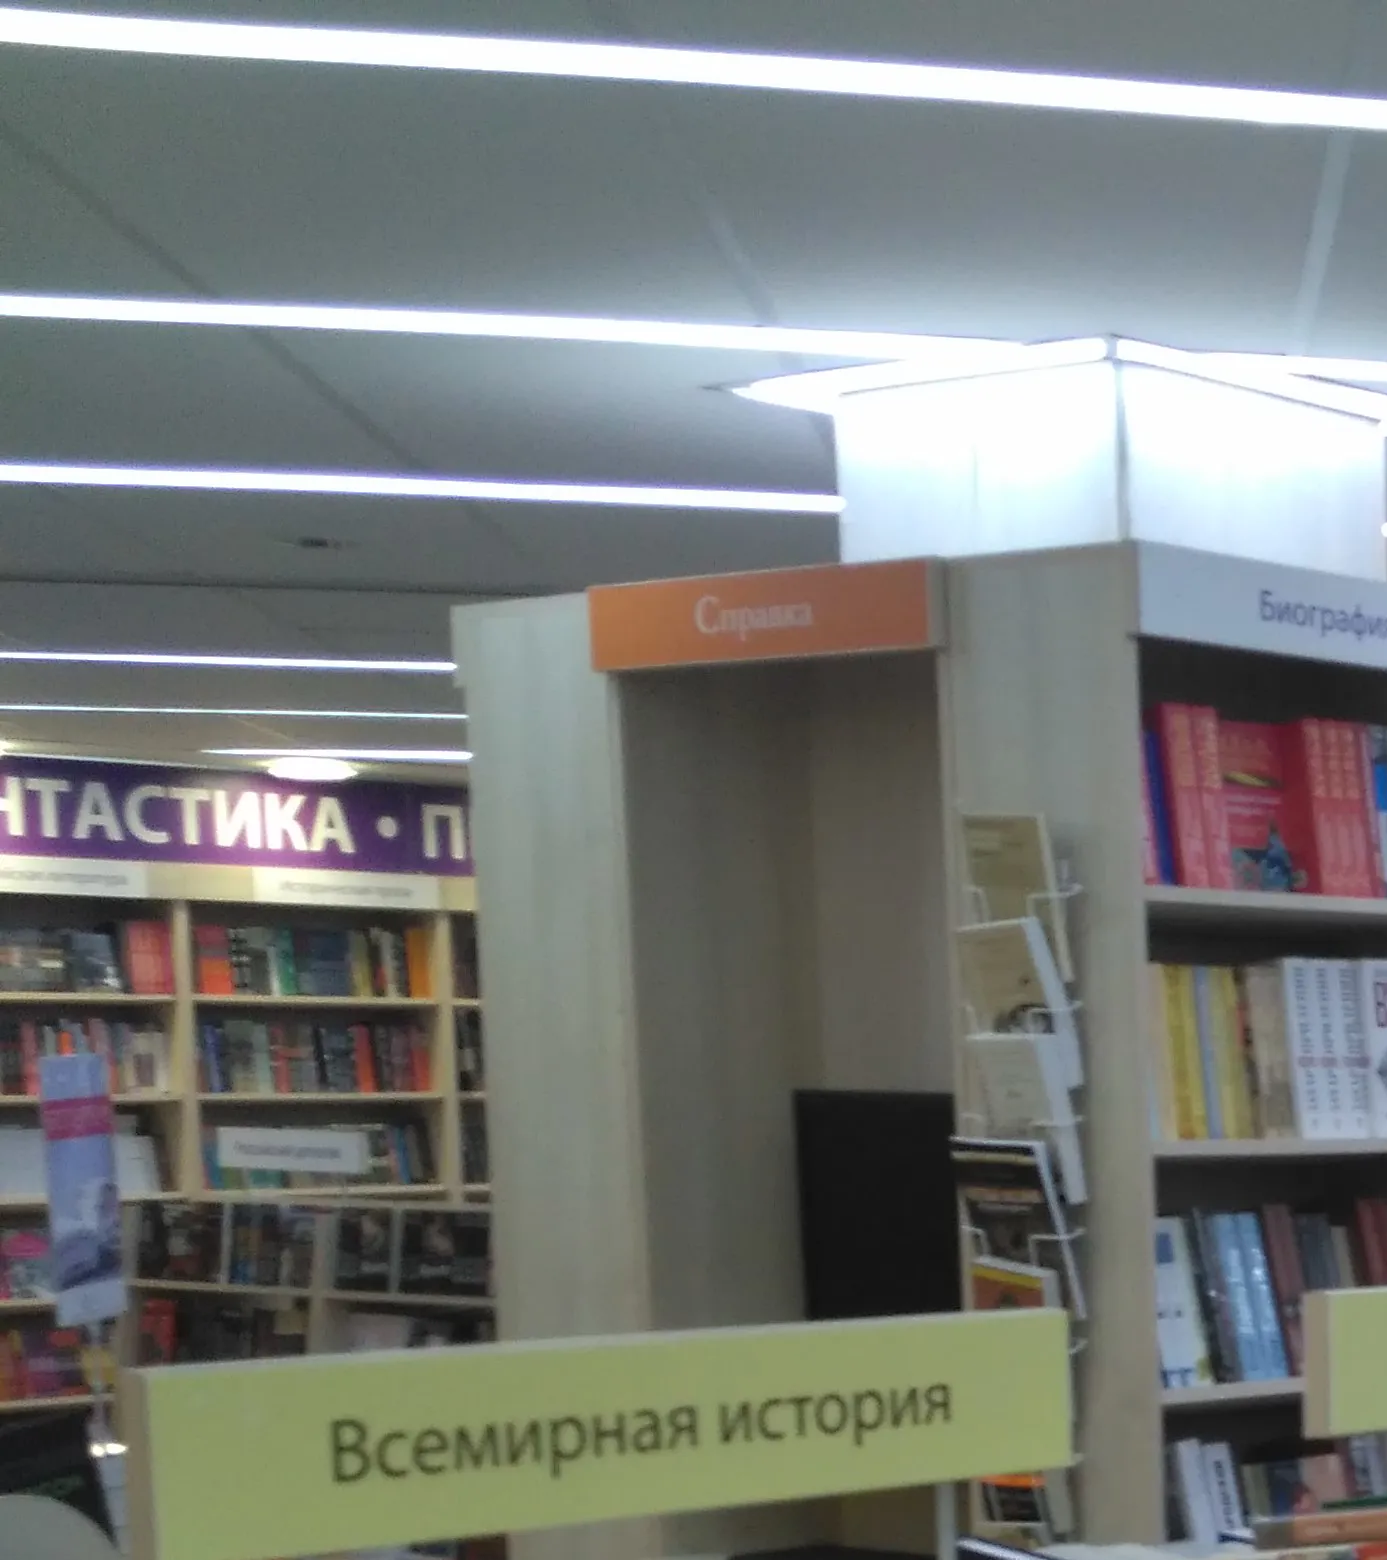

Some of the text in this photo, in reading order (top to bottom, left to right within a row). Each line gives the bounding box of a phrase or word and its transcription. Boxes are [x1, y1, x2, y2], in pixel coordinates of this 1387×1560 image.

[694, 594, 813, 638] Справка
[329, 1379, 953, 1485] Всемирная история
